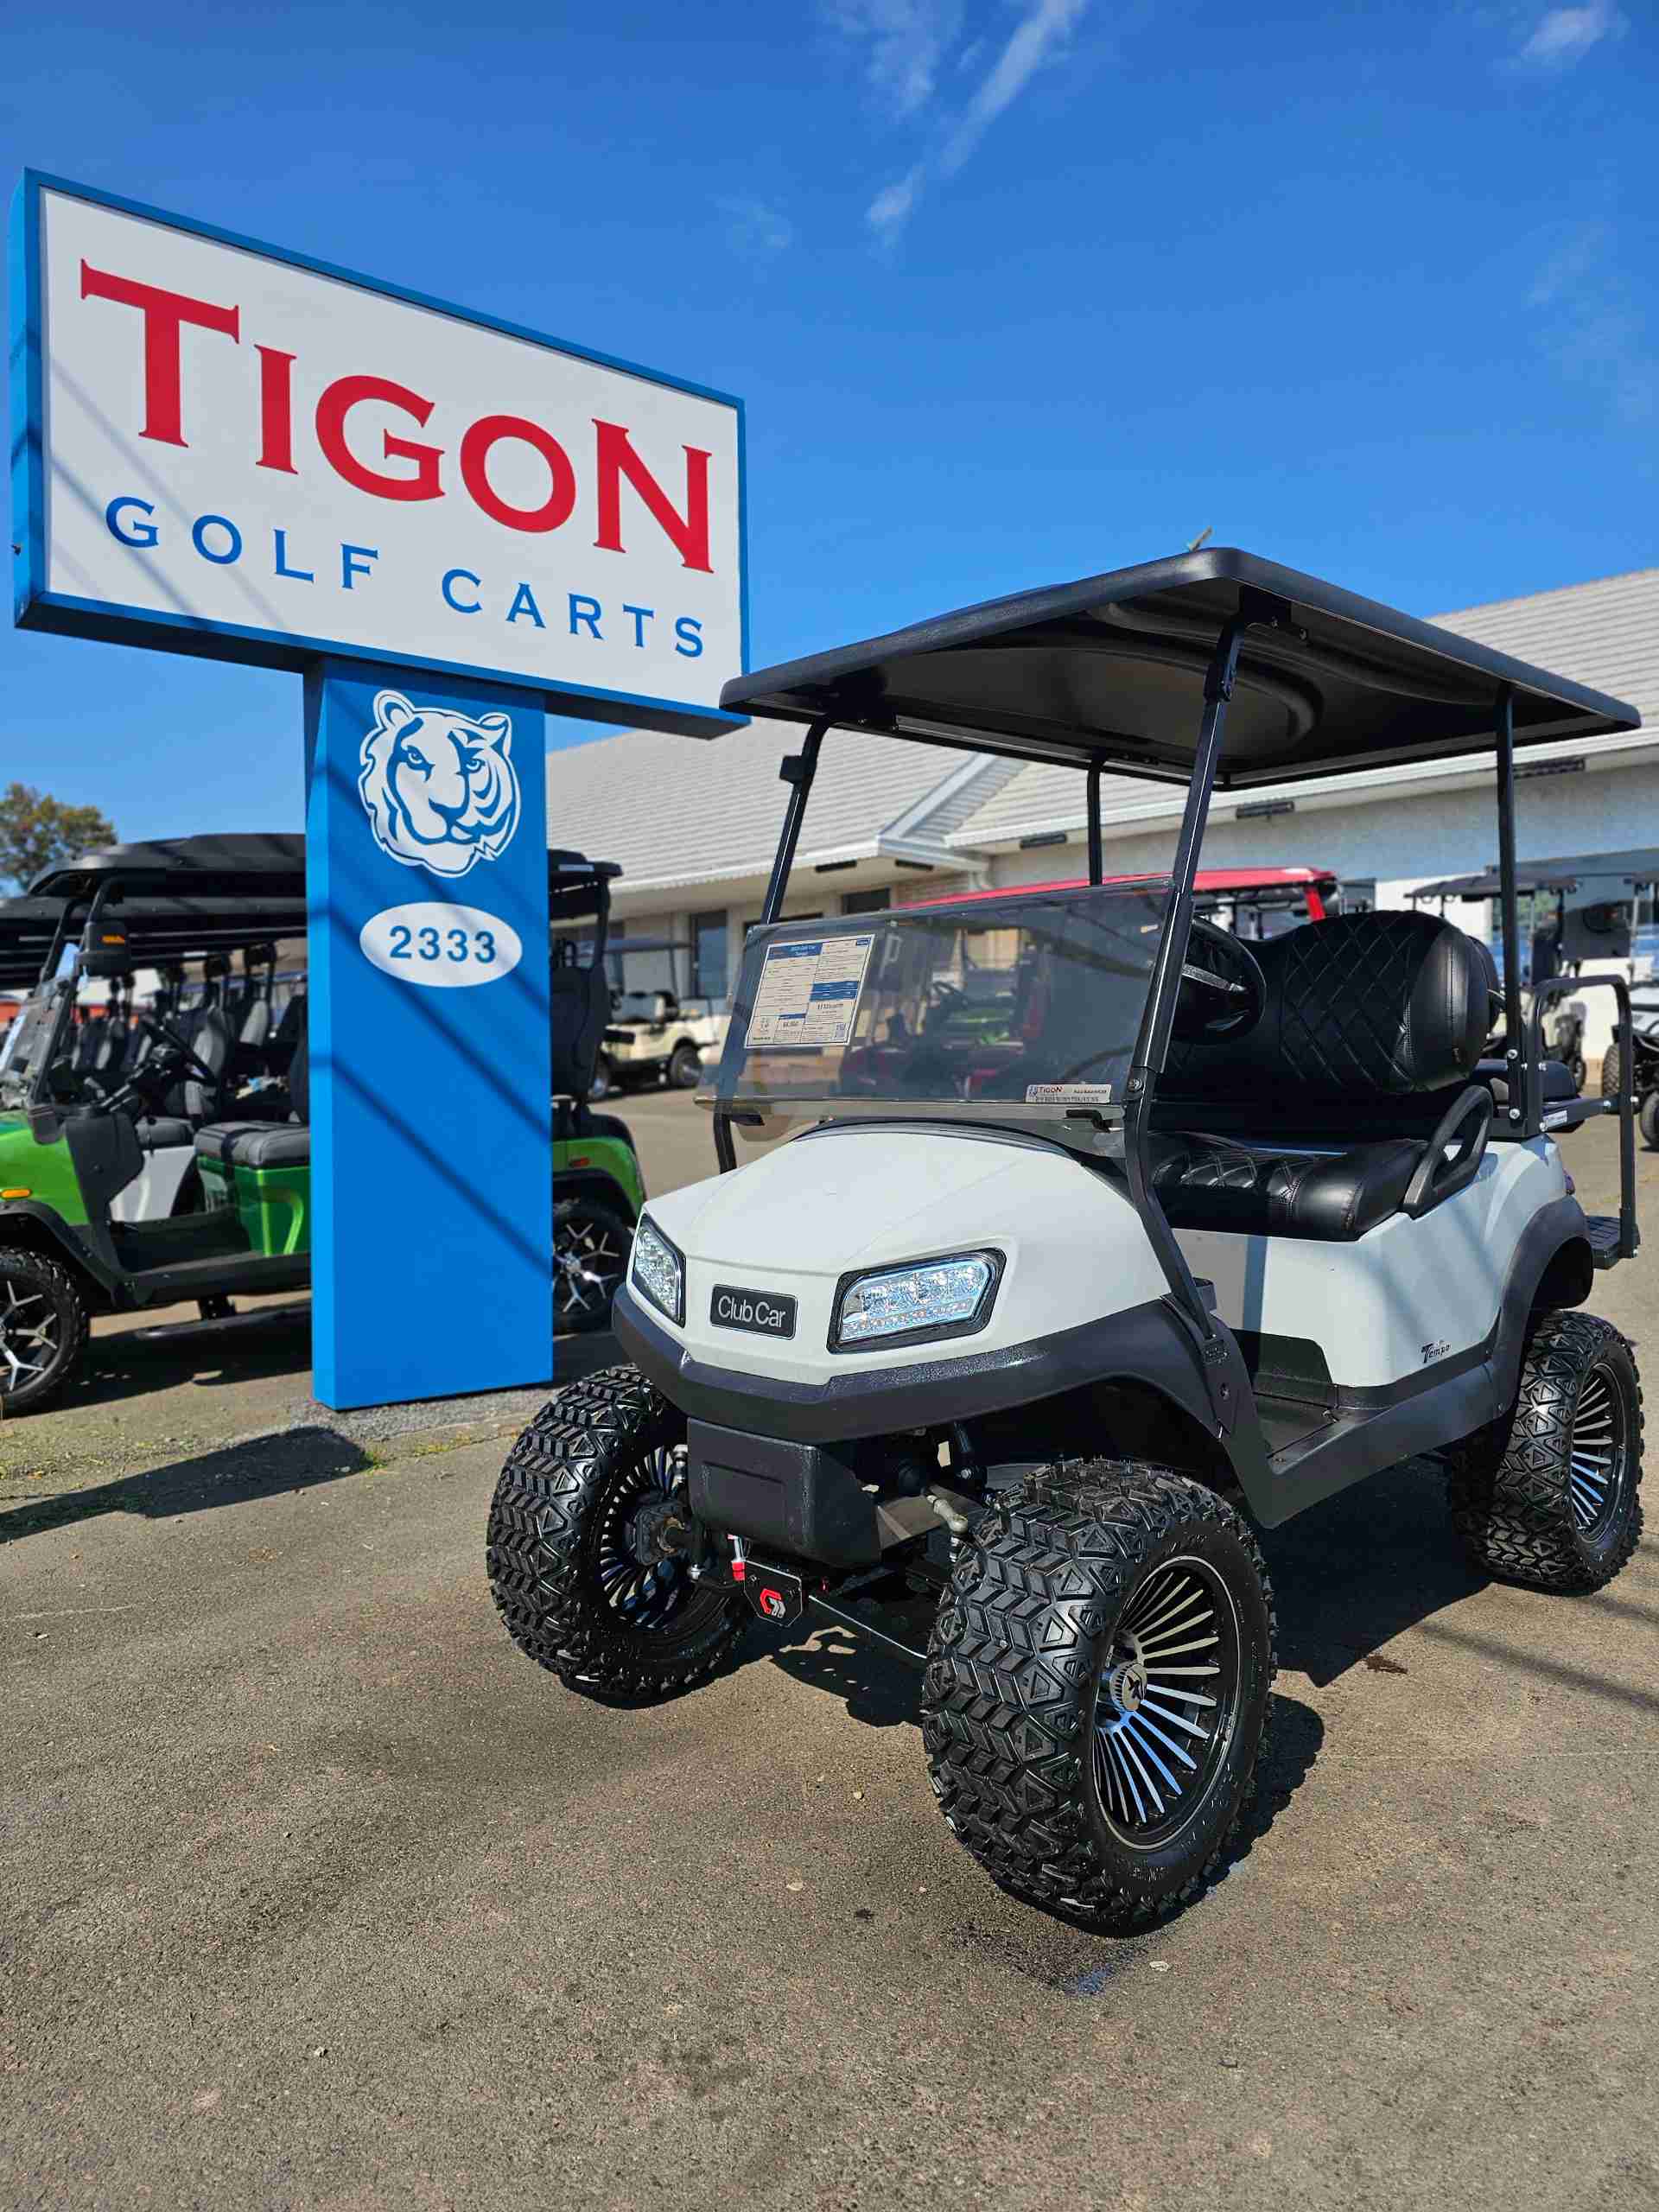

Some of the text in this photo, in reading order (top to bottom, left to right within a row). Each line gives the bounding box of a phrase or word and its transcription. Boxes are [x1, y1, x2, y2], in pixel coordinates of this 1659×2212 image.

[80, 258, 714, 574] TIGON
[105, 496, 705, 658] GOLF CARTS
[389, 925, 496, 963] 2333
[718, 1295, 786, 1327] Club Car
